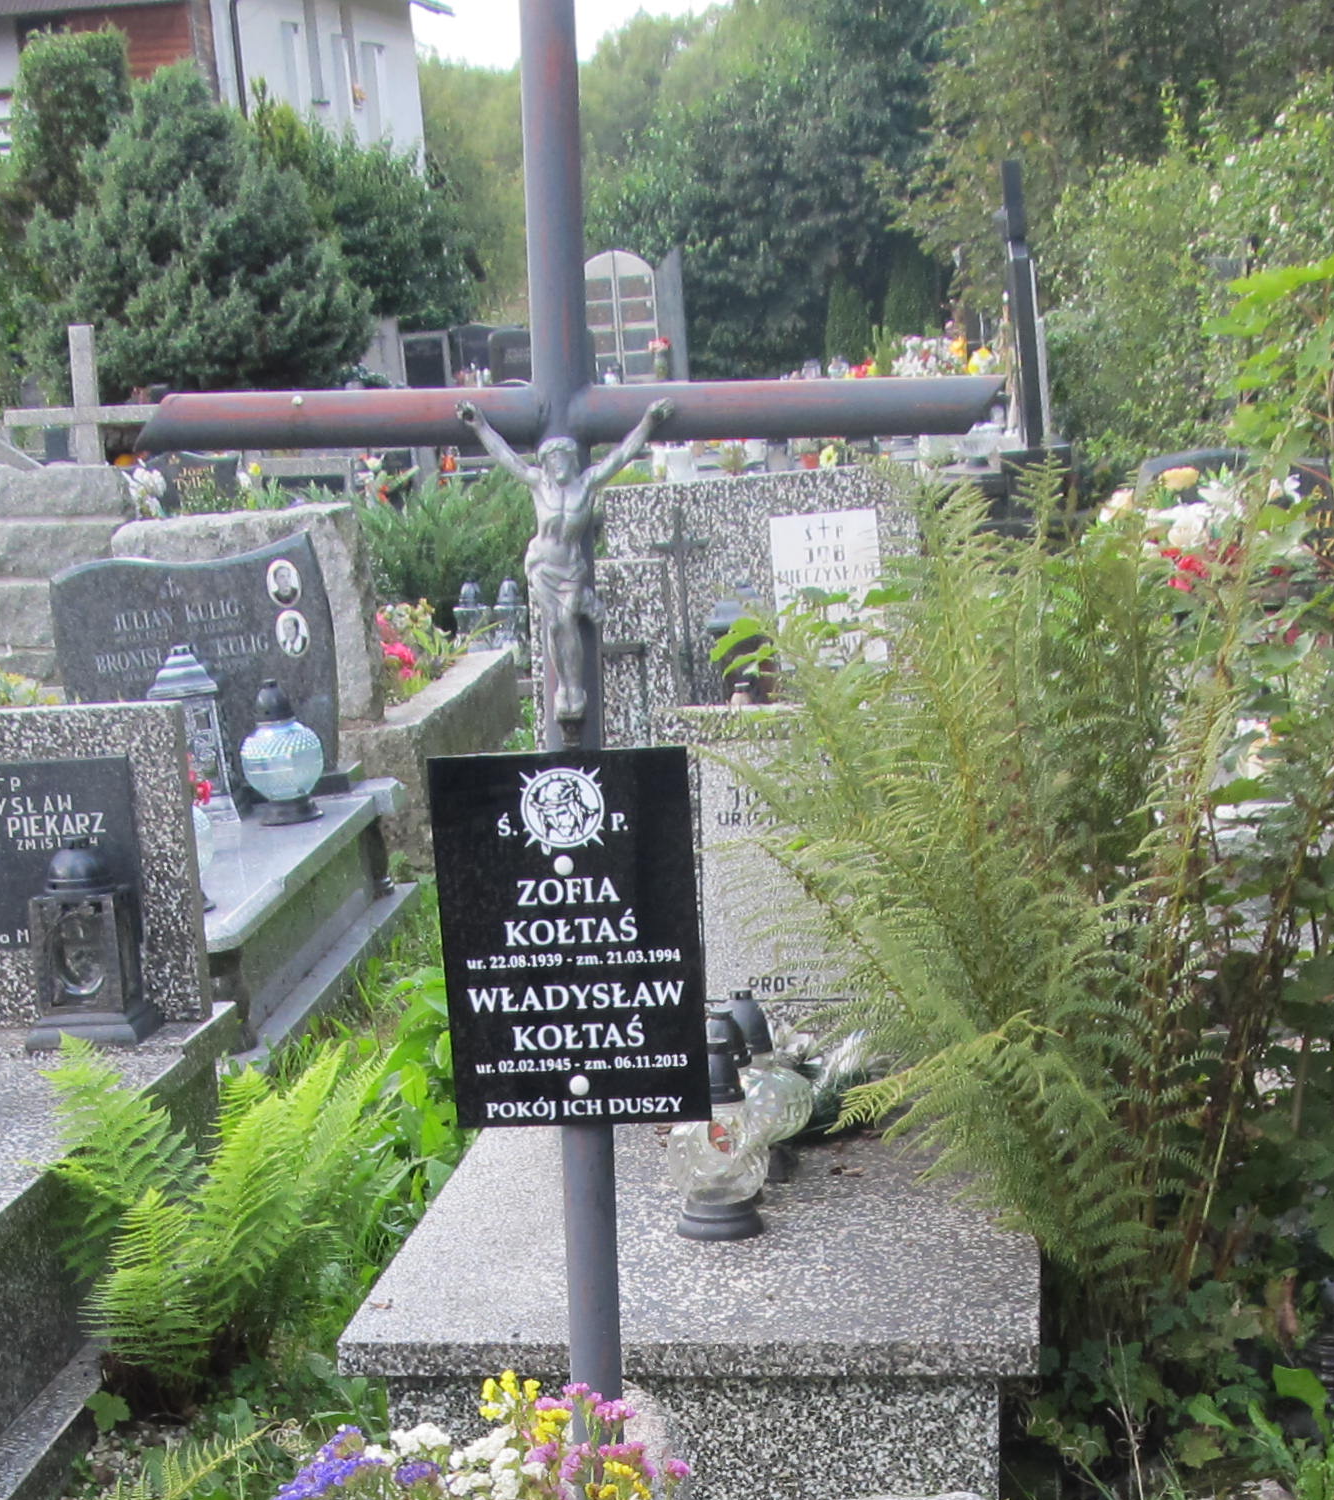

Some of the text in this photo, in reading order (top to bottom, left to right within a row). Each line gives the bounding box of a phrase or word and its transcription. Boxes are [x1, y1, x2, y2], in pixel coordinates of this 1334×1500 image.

[114, 607, 175, 632] JULIAN
[185, 599, 240, 623] KULIG
[217, 633, 269, 658] KULIG
[6, 812, 107, 839] PIEKARZ
[496, 811, 629, 837] Ś. P.
[16, 838, 37, 852] ZM
[517, 876, 621, 907] ZOFIA
[504, 908, 639, 947] KOŁTAŚ
[467, 957, 487, 971] ur.
[489, 952, 563, 970] 22.08.1939
[576, 954, 604, 967] zm.
[606, 948, 682, 965] 21.03.1994
[467, 980, 685, 1013] WŁADYSŁAW
[512, 1014, 646, 1052] KOŁTAŚ
[475, 1063, 496, 1075] ur.
[498, 1057, 572, 1073] 02.02.1945
[584, 1058, 612, 1071] zm.
[614, 1053, 688, 1069] 06.11.2013
[486, 1096, 683, 1120] POKÓJ ICH DUSZY
